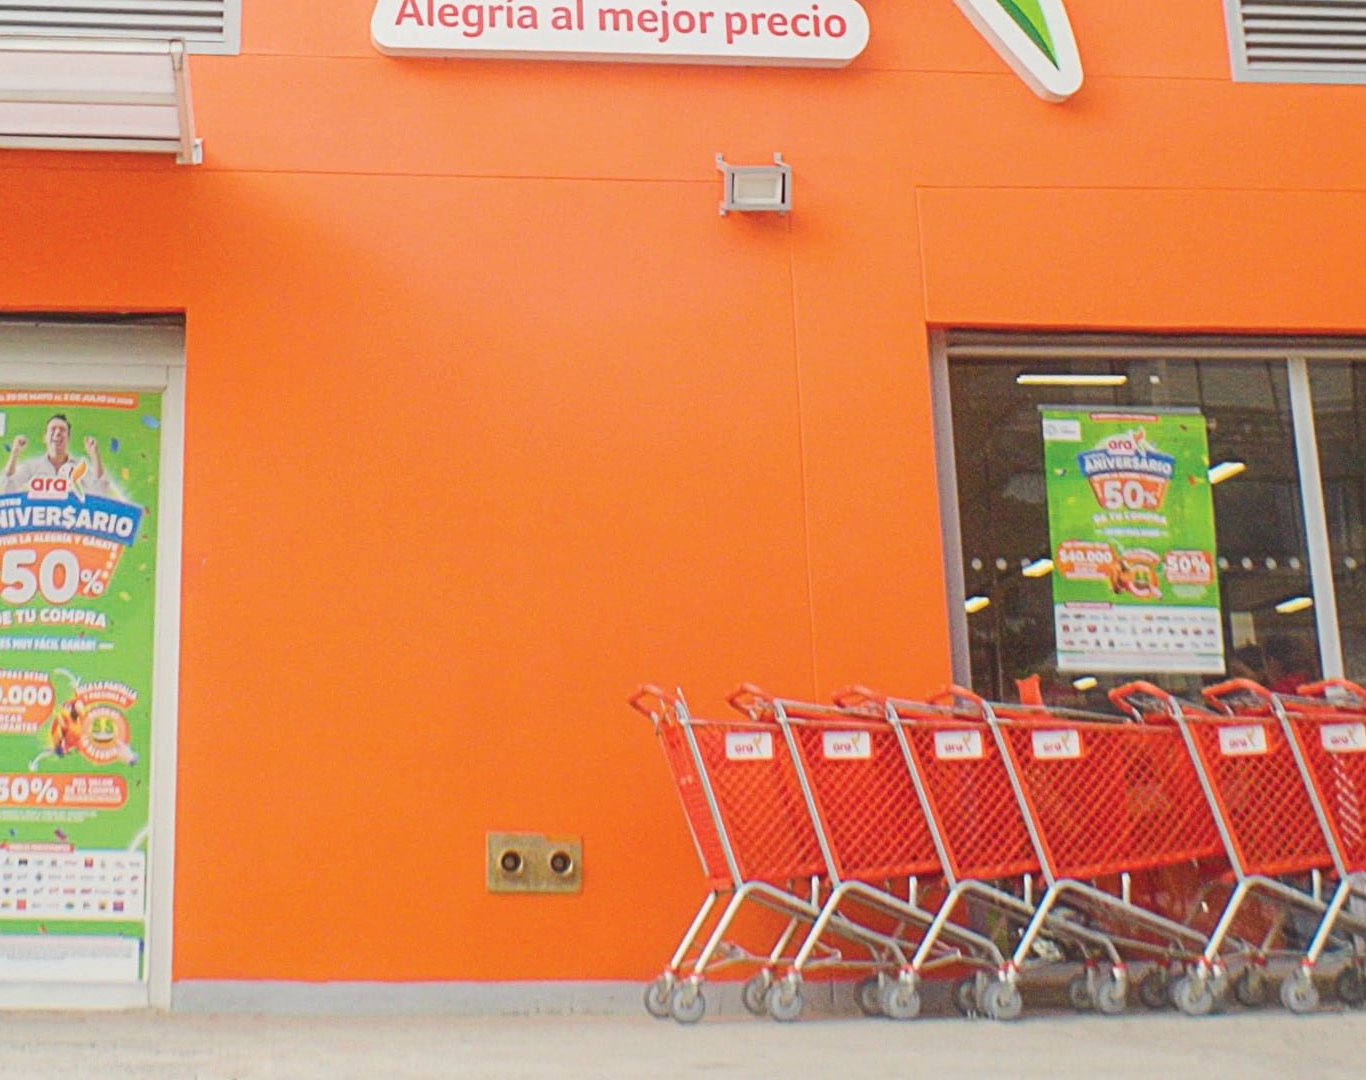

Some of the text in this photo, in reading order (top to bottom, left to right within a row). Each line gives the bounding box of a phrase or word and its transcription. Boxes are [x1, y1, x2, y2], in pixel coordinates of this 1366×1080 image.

[598, 0, 714, 43] mejor
[724, 6, 847, 43] precio
[1109, 440, 1132, 450] ara
[31, 477, 67, 492] ara
[1103, 479, 1157, 510] 50%
[19, 533, 33, 543] LA
[1059, 549, 1113, 563] $40.000
[1166, 556, 1210, 573] 50%
[1, 548, 105, 604] 50%
[16, 609, 37, 624] TU
[39, 609, 107, 628] COMPRA
[1228, 738, 1247, 748] ara
[1330, 735, 1349, 744] ara
[734, 744, 753, 753] ara
[833, 742, 852, 752] ara
[945, 744, 963, 752] ara
[1043, 742, 1061, 752] ara
